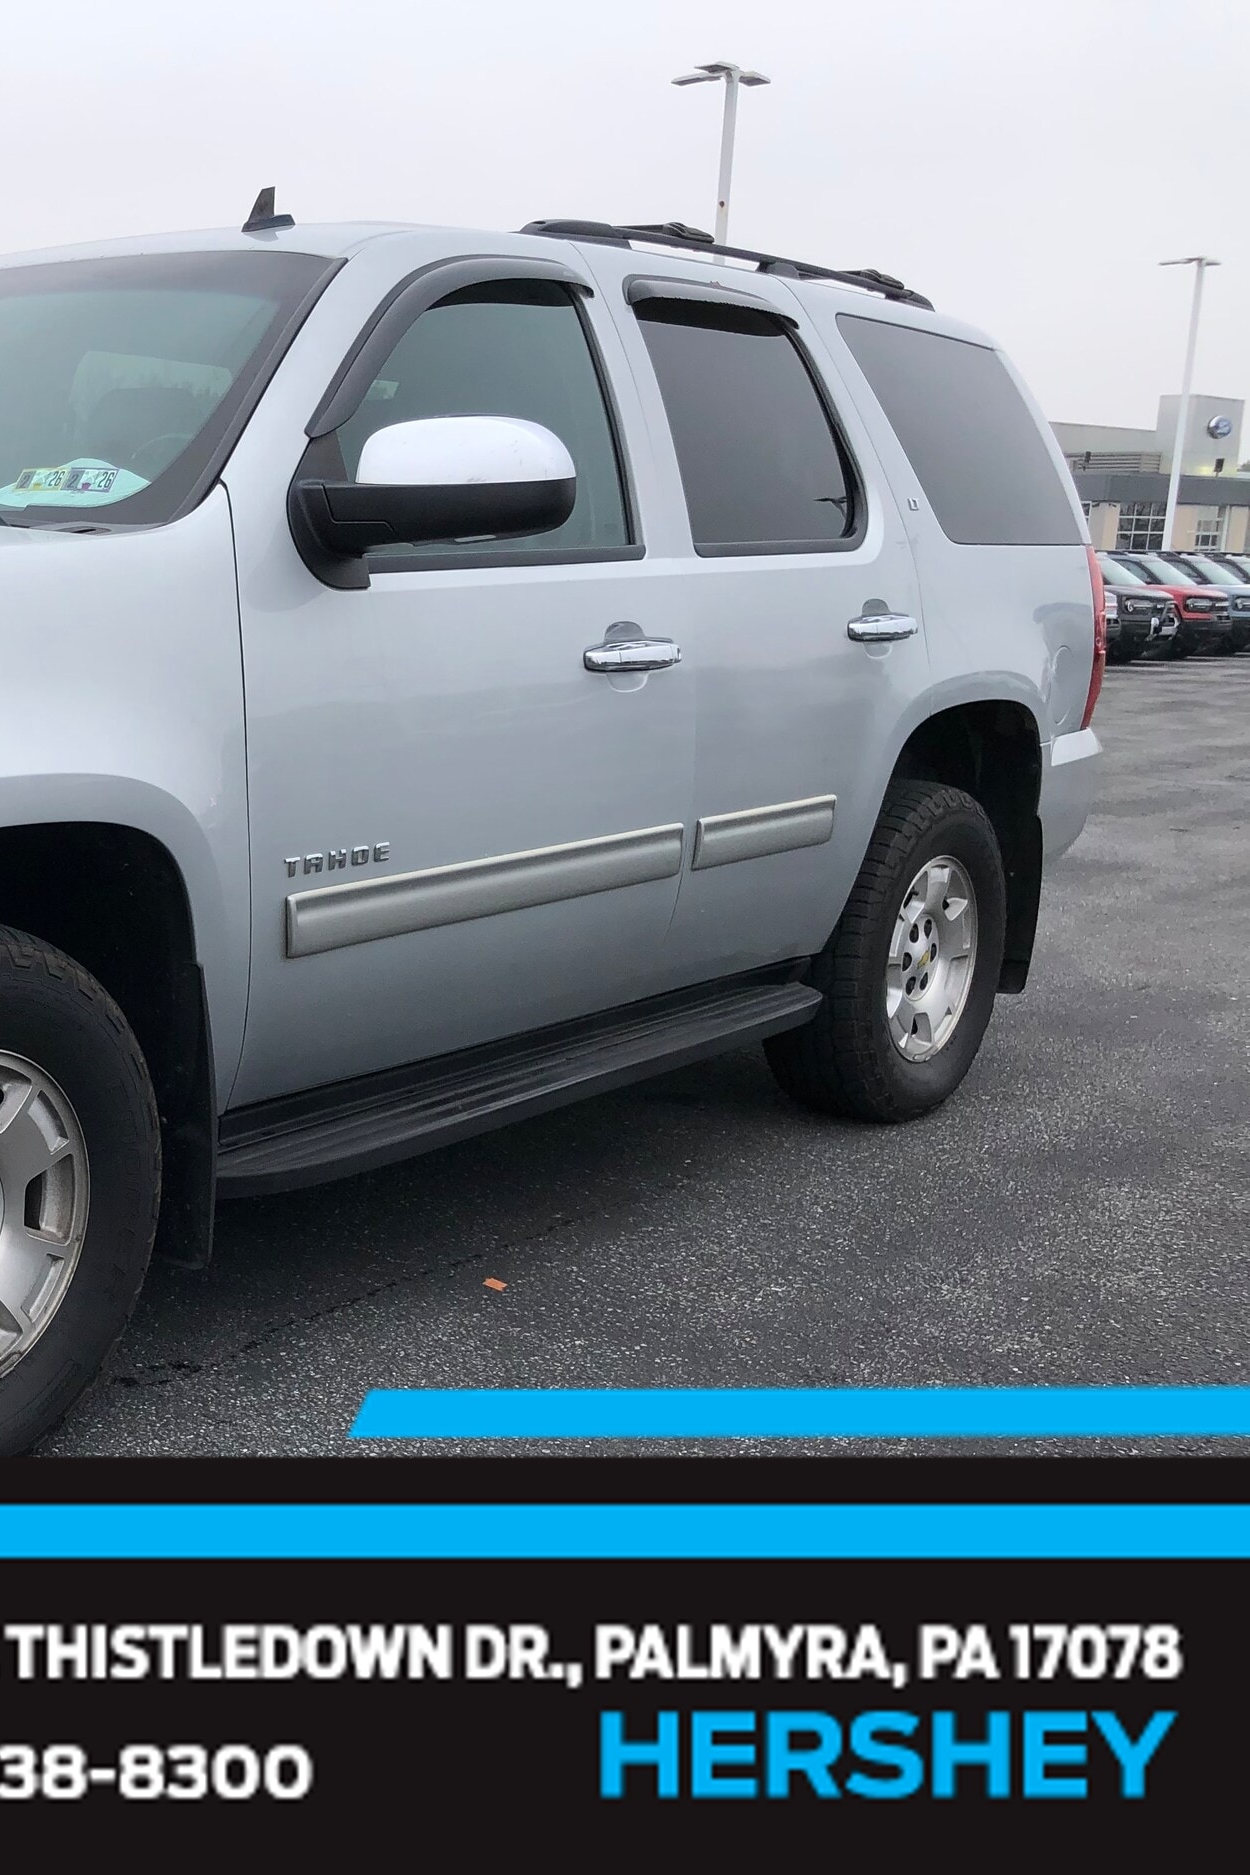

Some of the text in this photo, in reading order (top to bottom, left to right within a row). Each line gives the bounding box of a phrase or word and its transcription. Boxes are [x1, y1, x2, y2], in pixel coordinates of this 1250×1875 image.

[48, 470, 65, 487] 26
[97, 471, 115, 488] 26
[284, 842, 390, 878] TAHOE
